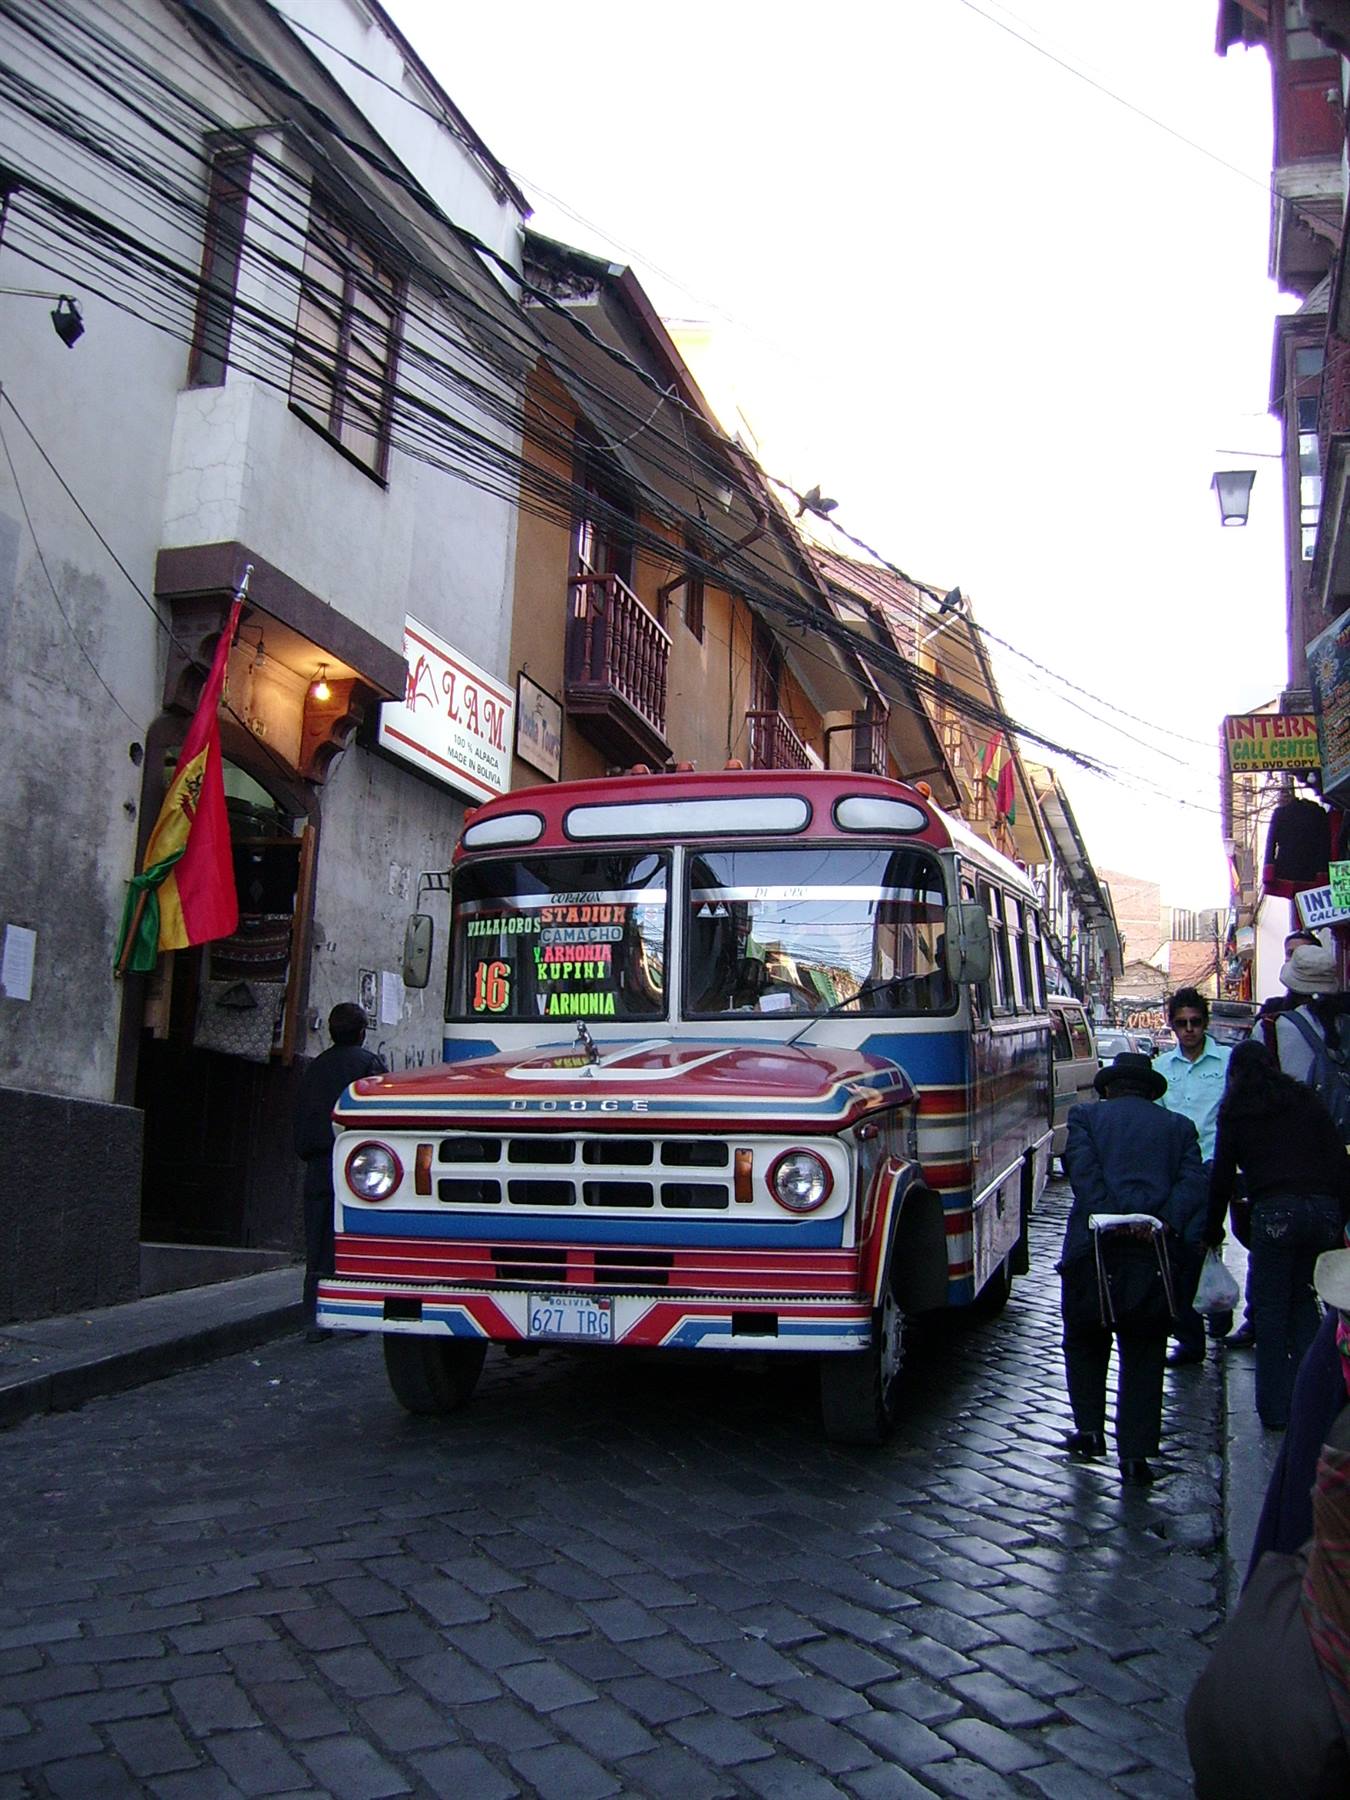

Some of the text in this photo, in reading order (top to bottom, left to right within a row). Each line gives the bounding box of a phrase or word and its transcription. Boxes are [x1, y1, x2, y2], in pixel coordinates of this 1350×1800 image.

[475, 747, 499, 769] ALPACA
[1233, 740, 1265, 760] CALL
[448, 746, 501, 786] MADE IN BOLIVIA
[1233, 760, 1315, 770] CD & DVD COPY
[540, 906, 625, 923] STADIUM
[1310, 908, 1338, 923] CALL
[467, 917, 541, 937] VILLALOBOS
[541, 927, 623, 943] CAMACHO
[473, 960, 511, 1012] 16
[509, 1099, 649, 1112] DODGE
[549, 1298, 592, 1307] BOLIVIA
[532, 1308, 609, 1335] 627 TRG
